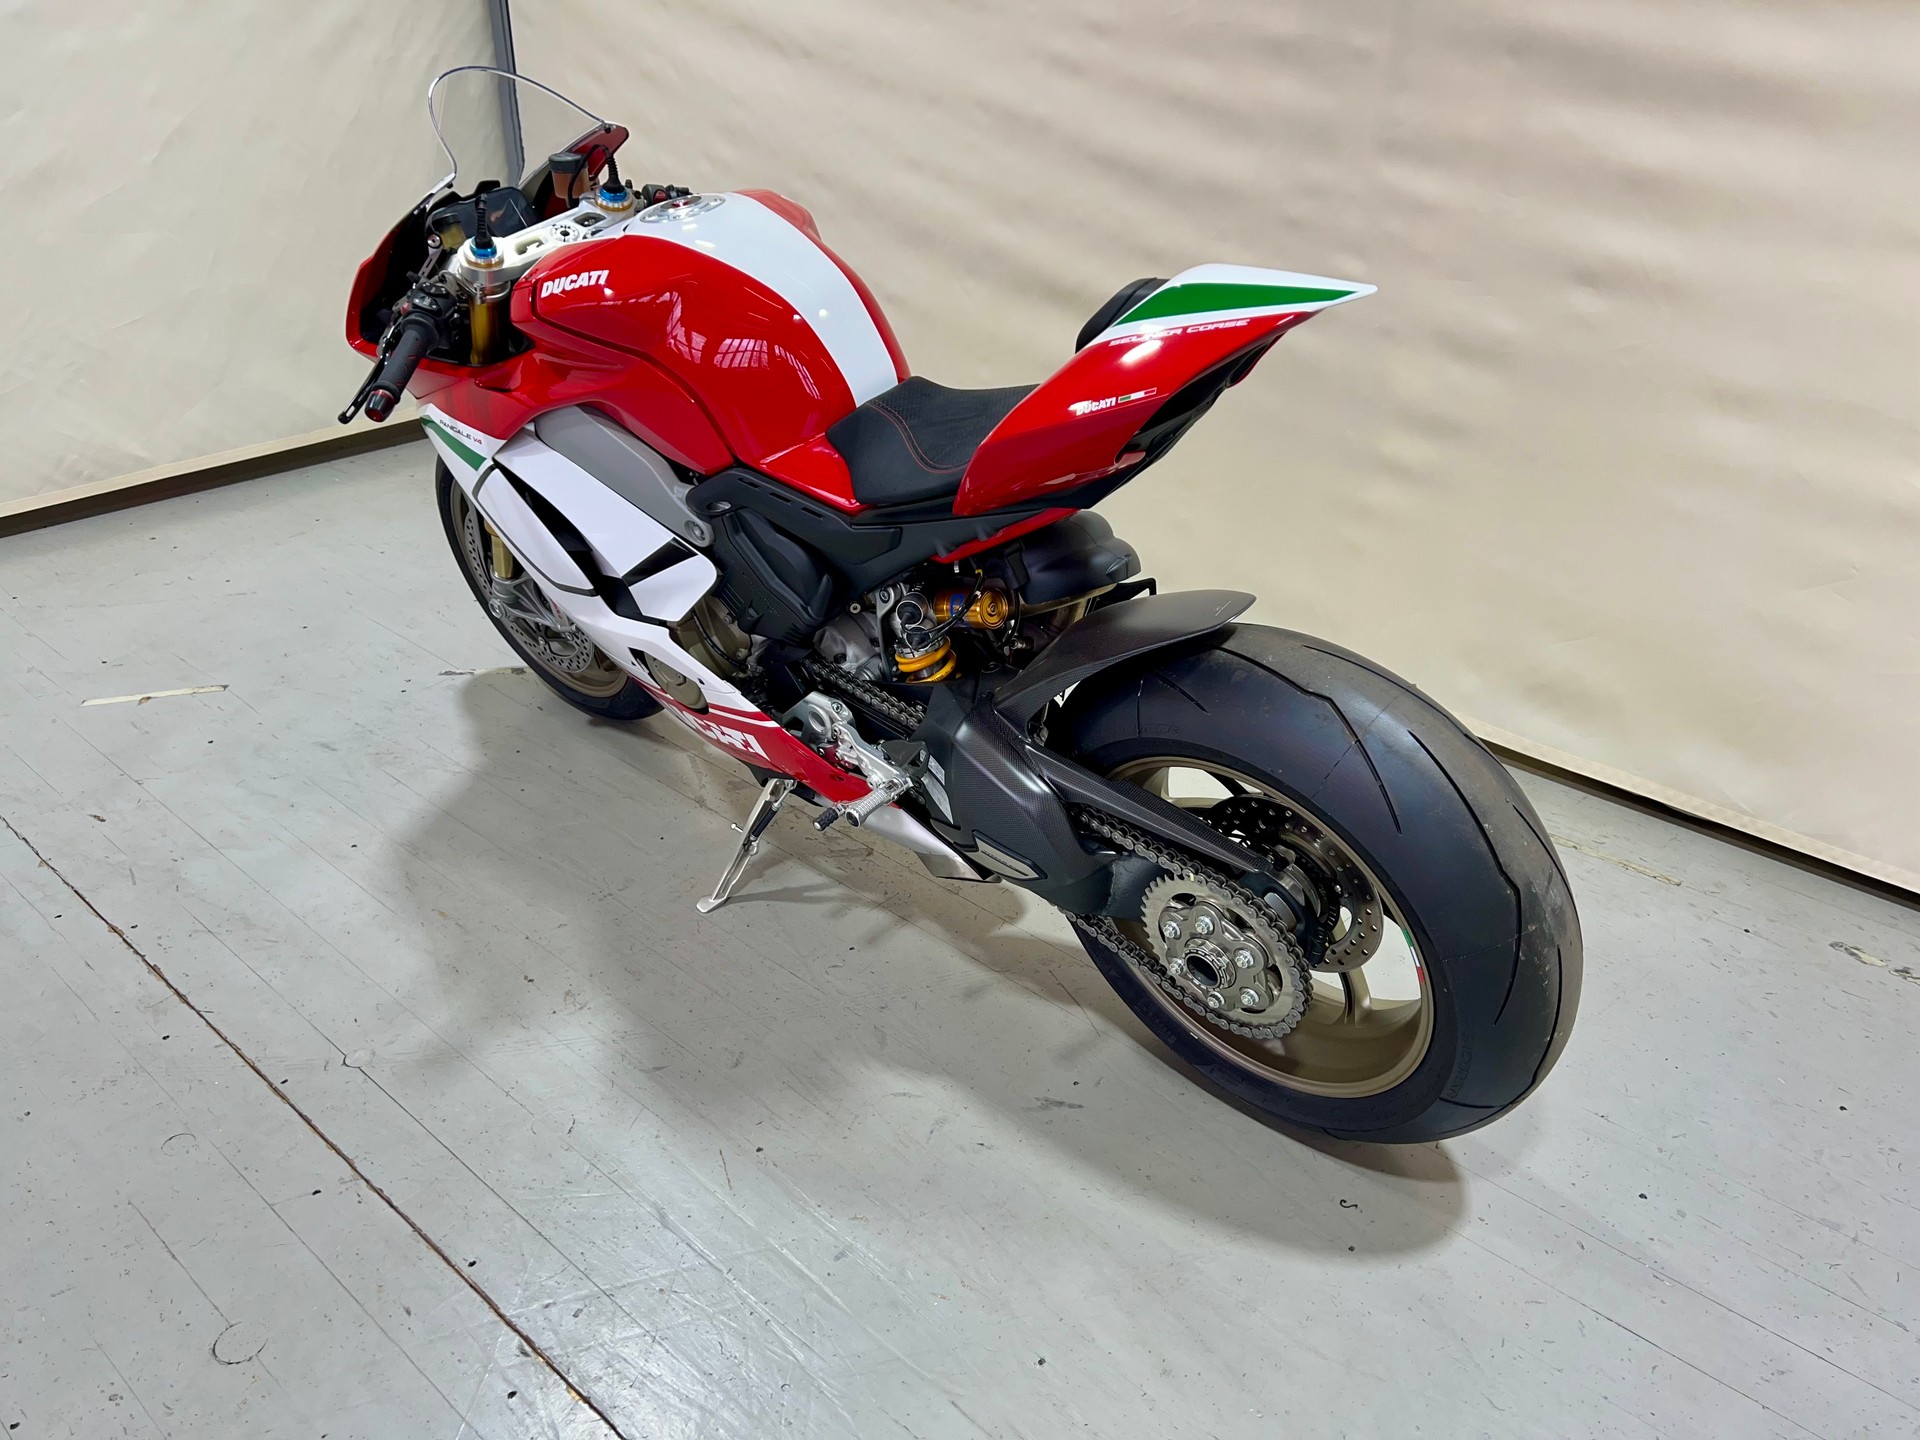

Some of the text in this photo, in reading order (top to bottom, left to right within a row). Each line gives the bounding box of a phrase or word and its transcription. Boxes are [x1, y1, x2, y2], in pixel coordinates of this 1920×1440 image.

[540, 269, 609, 299] DUCATI
[1186, 319, 1250, 333] CORSE
[439, 419, 483, 445] PANIGALE V4
